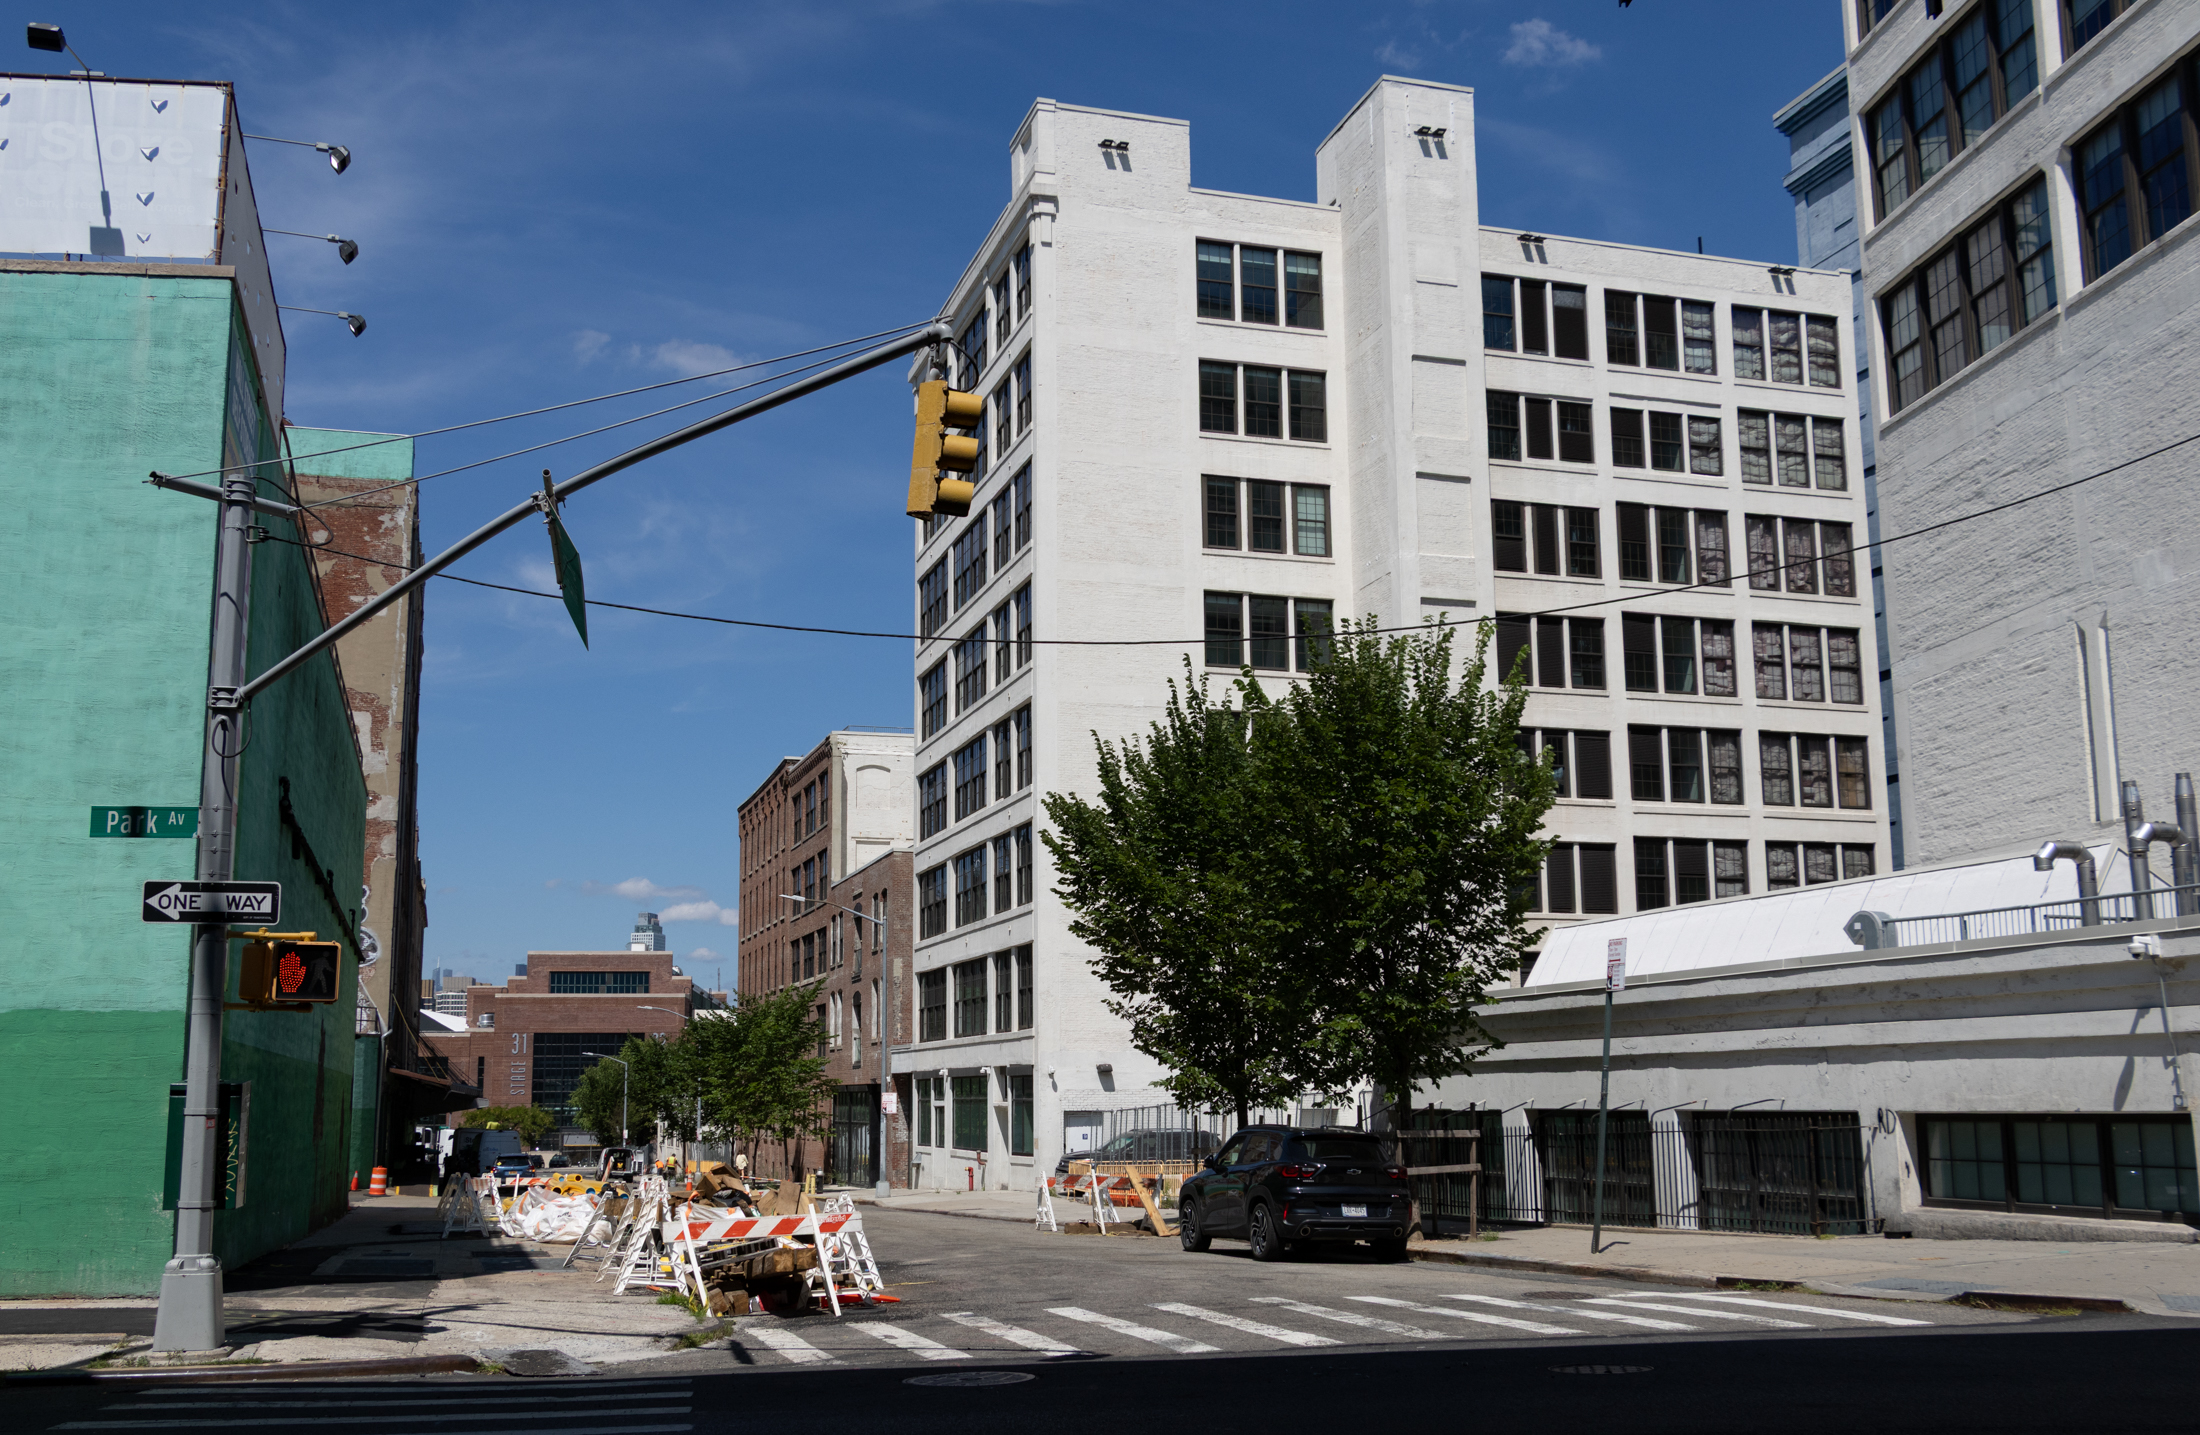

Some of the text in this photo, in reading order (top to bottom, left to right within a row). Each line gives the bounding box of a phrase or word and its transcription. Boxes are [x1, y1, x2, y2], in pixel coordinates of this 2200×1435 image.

[25, 120, 193, 165] iStore
[107, 810, 185, 834] Park Av
[158, 894, 267, 910] ONE WAY
[511, 1032, 527, 1055] 31
[510, 1061, 526, 1095] STAGE
